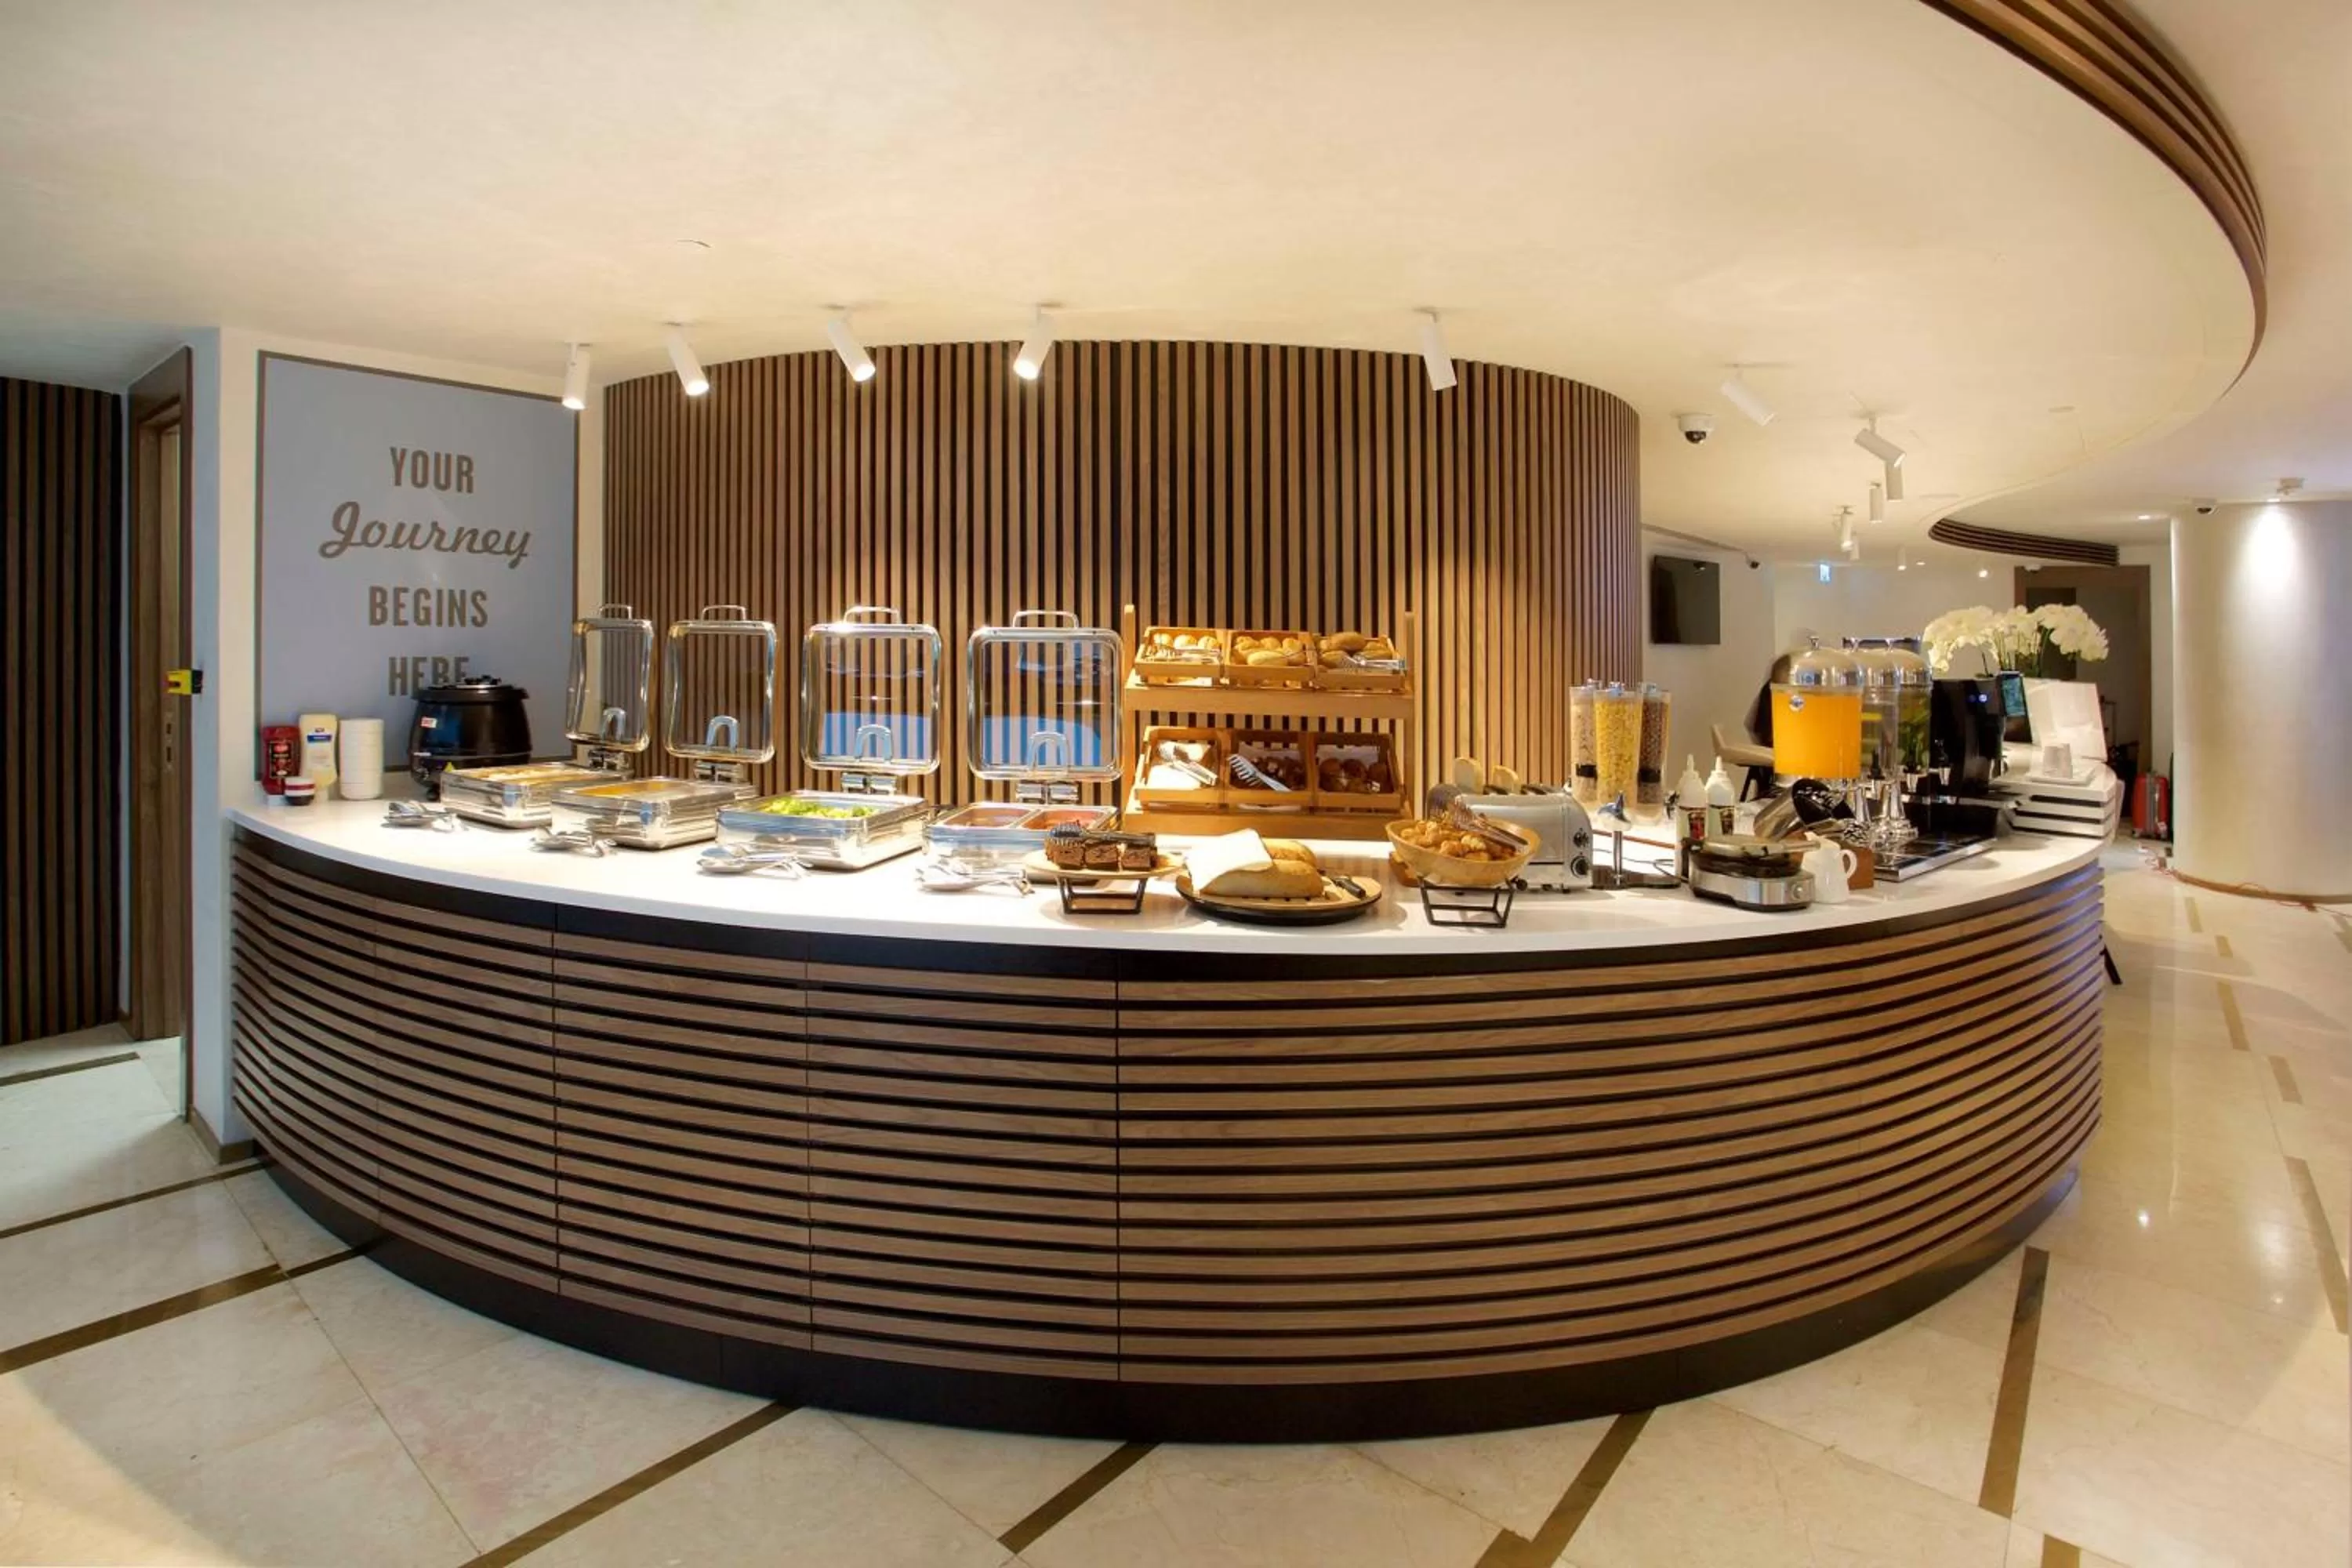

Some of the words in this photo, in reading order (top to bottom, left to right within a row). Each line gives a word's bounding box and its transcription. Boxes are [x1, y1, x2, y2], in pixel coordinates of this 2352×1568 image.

[390, 447, 474, 493] YOUR
[318, 501, 531, 569] Journey
[368, 586, 488, 627] BEGINS
[388, 656, 469, 696] HERE
